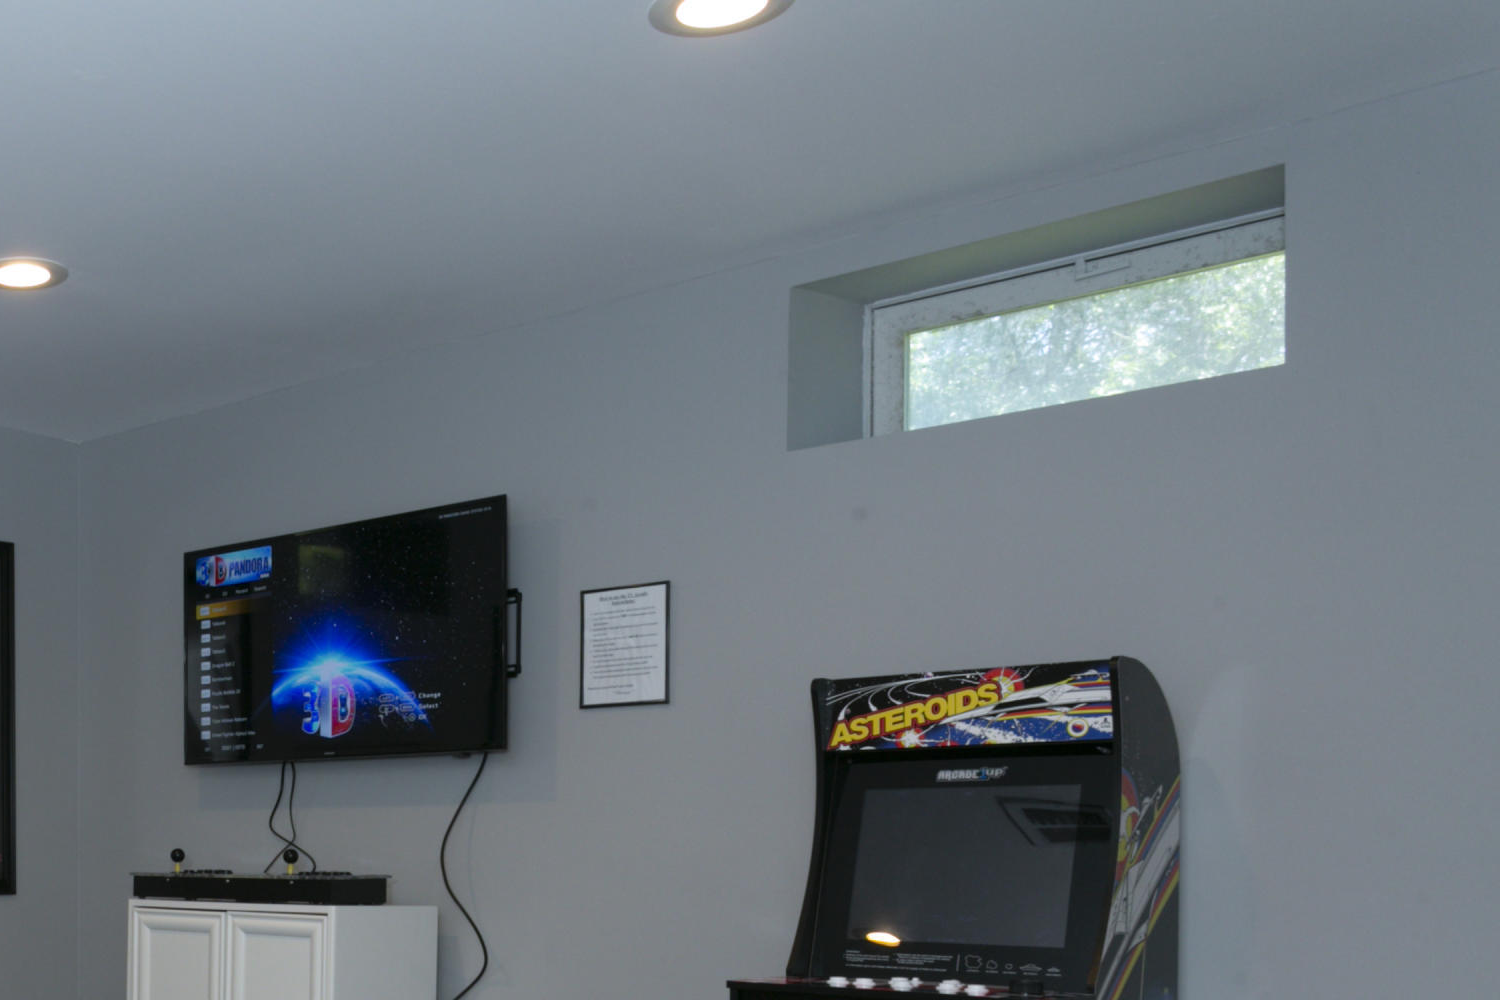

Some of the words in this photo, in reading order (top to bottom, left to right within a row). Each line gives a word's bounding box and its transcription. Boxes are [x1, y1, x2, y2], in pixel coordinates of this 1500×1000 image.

[229, 556, 269, 577] PANDORA
[301, 674, 356, 738] 3D
[829, 682, 1000, 748] ASTEROIDS
